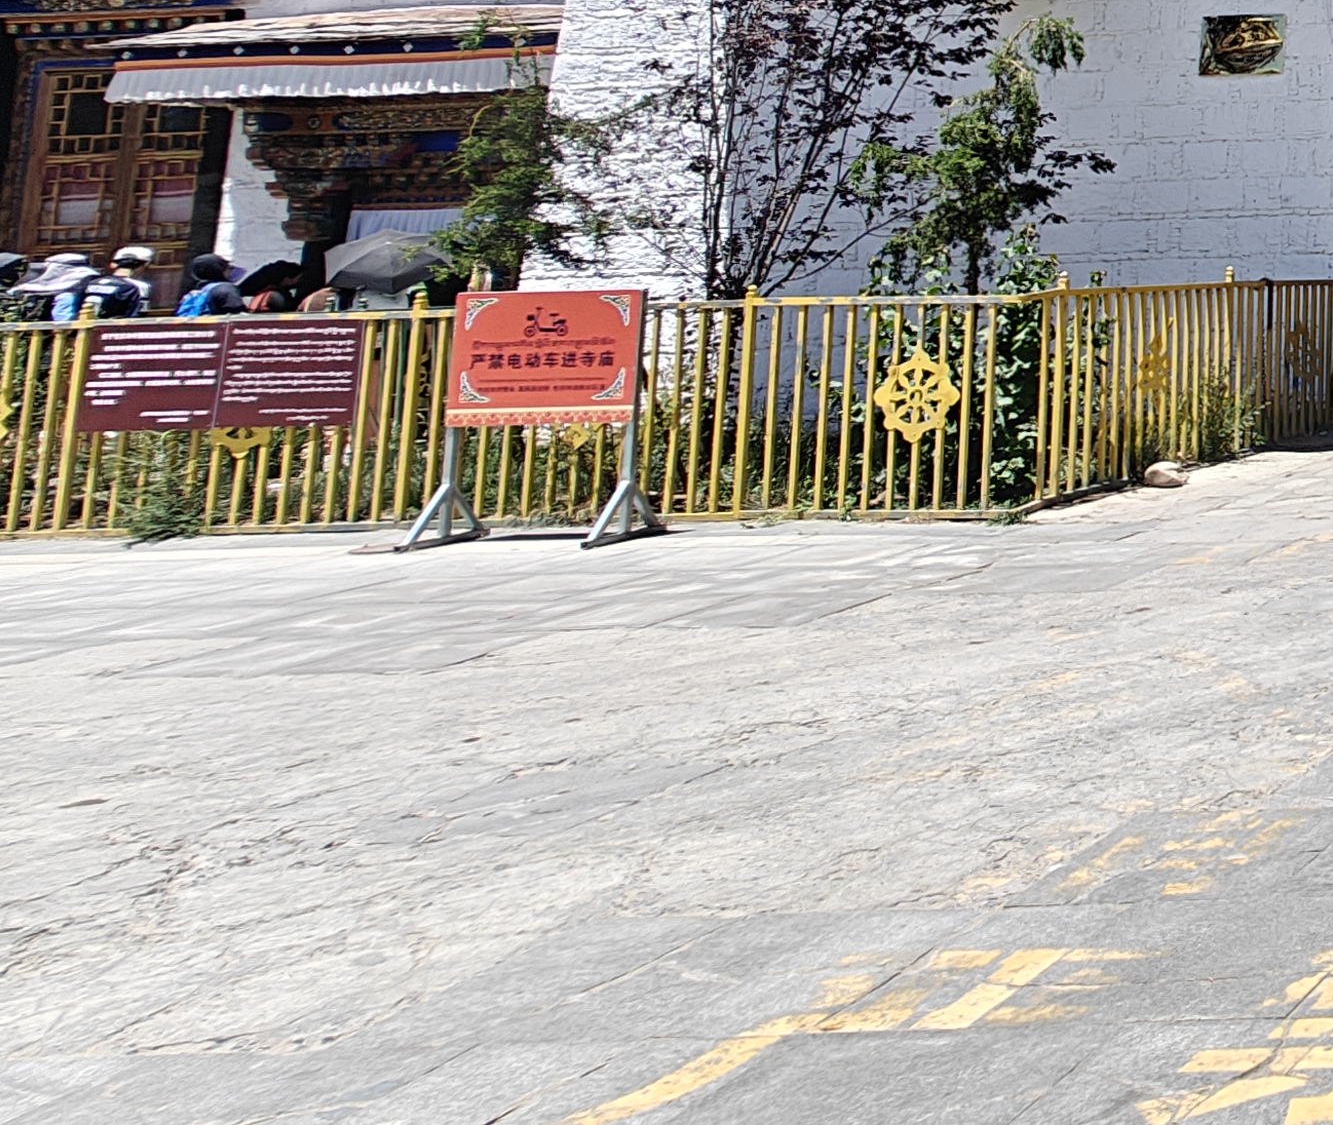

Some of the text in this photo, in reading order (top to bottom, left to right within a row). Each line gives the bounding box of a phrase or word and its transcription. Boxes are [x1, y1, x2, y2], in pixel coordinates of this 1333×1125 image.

[470, 350, 616, 371] 严禁电动车进寺庙
